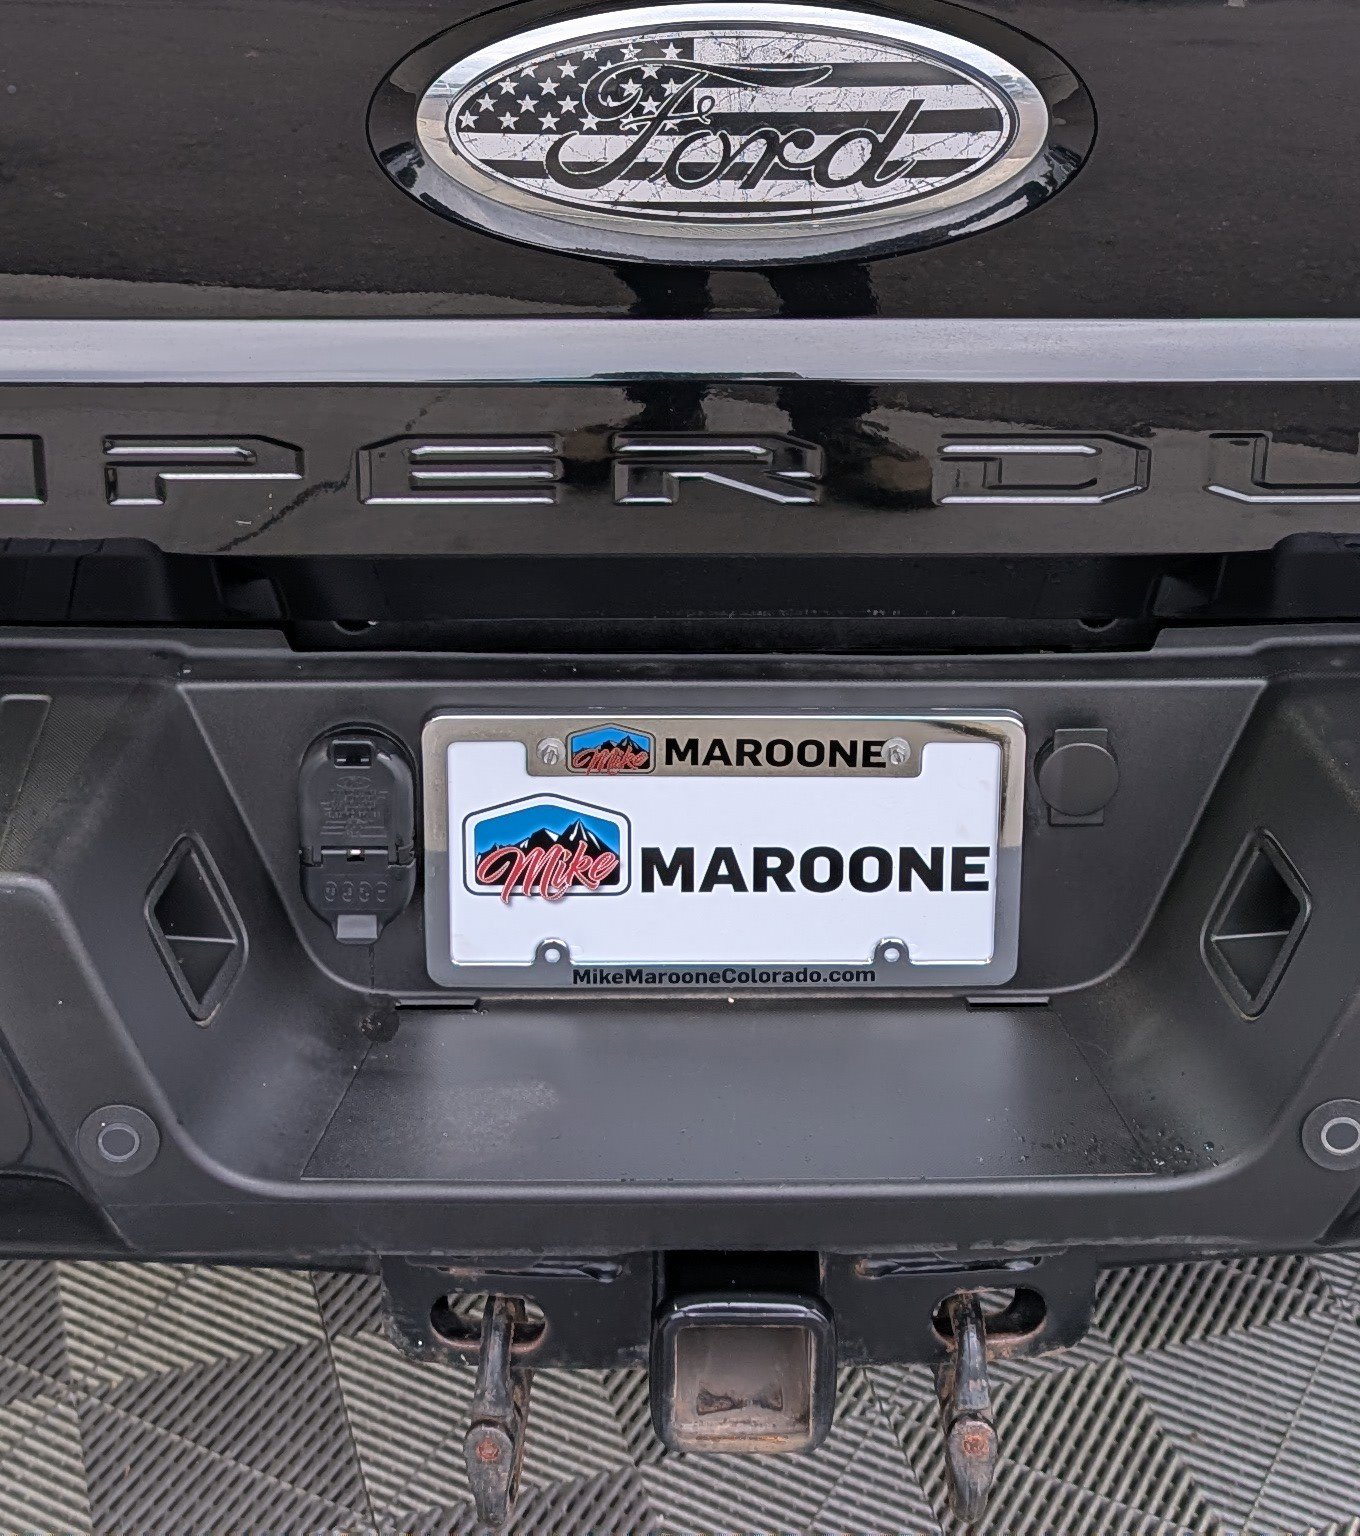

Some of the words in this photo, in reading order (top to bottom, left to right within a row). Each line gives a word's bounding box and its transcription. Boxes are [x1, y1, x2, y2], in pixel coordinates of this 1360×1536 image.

[543, 57, 924, 192] Ford
[572, 744, 649, 776] Mike
[664, 737, 887, 768] MAROONE
[477, 840, 619, 905] Mike
[641, 846, 990, 893] MAROONE
[572, 966, 877, 986] MikeMarooneColorado.com
